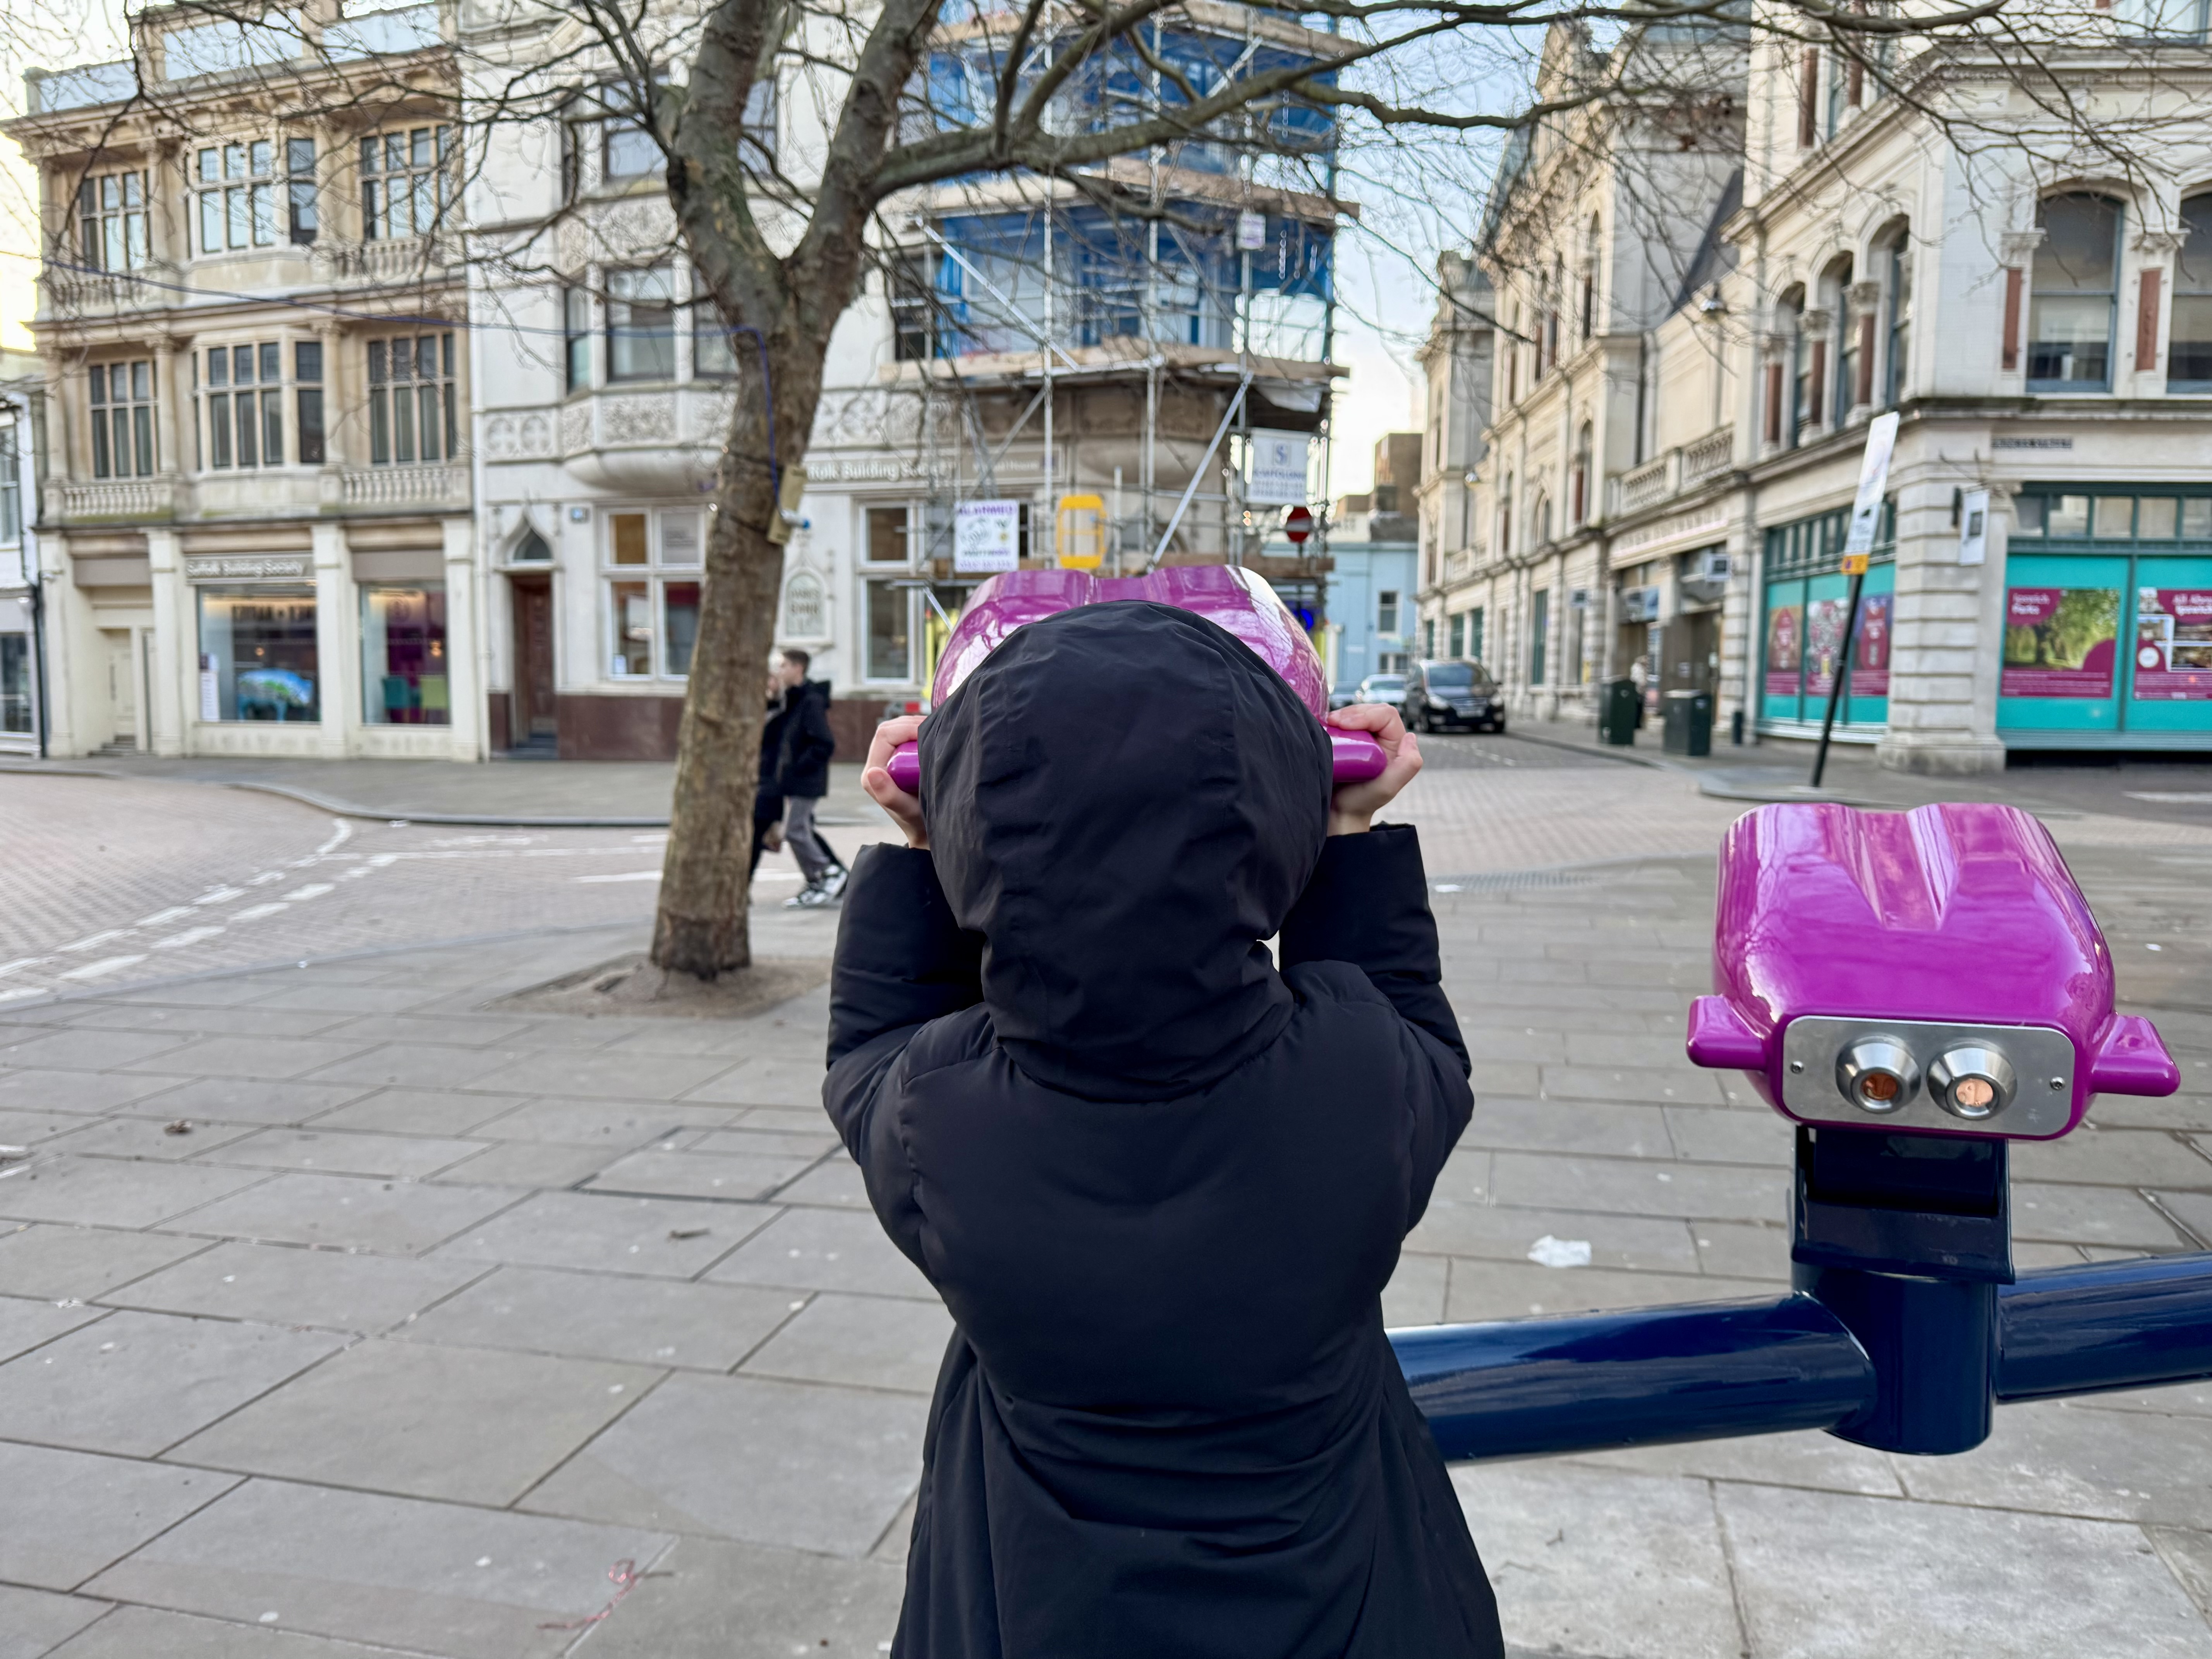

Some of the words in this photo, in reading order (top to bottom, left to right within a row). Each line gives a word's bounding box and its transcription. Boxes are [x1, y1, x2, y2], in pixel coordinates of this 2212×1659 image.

[841, 461, 900, 481] Building
[187, 561, 221, 576] Suffolk
[222, 560, 261, 578] Building
[262, 560, 304, 575] Society
